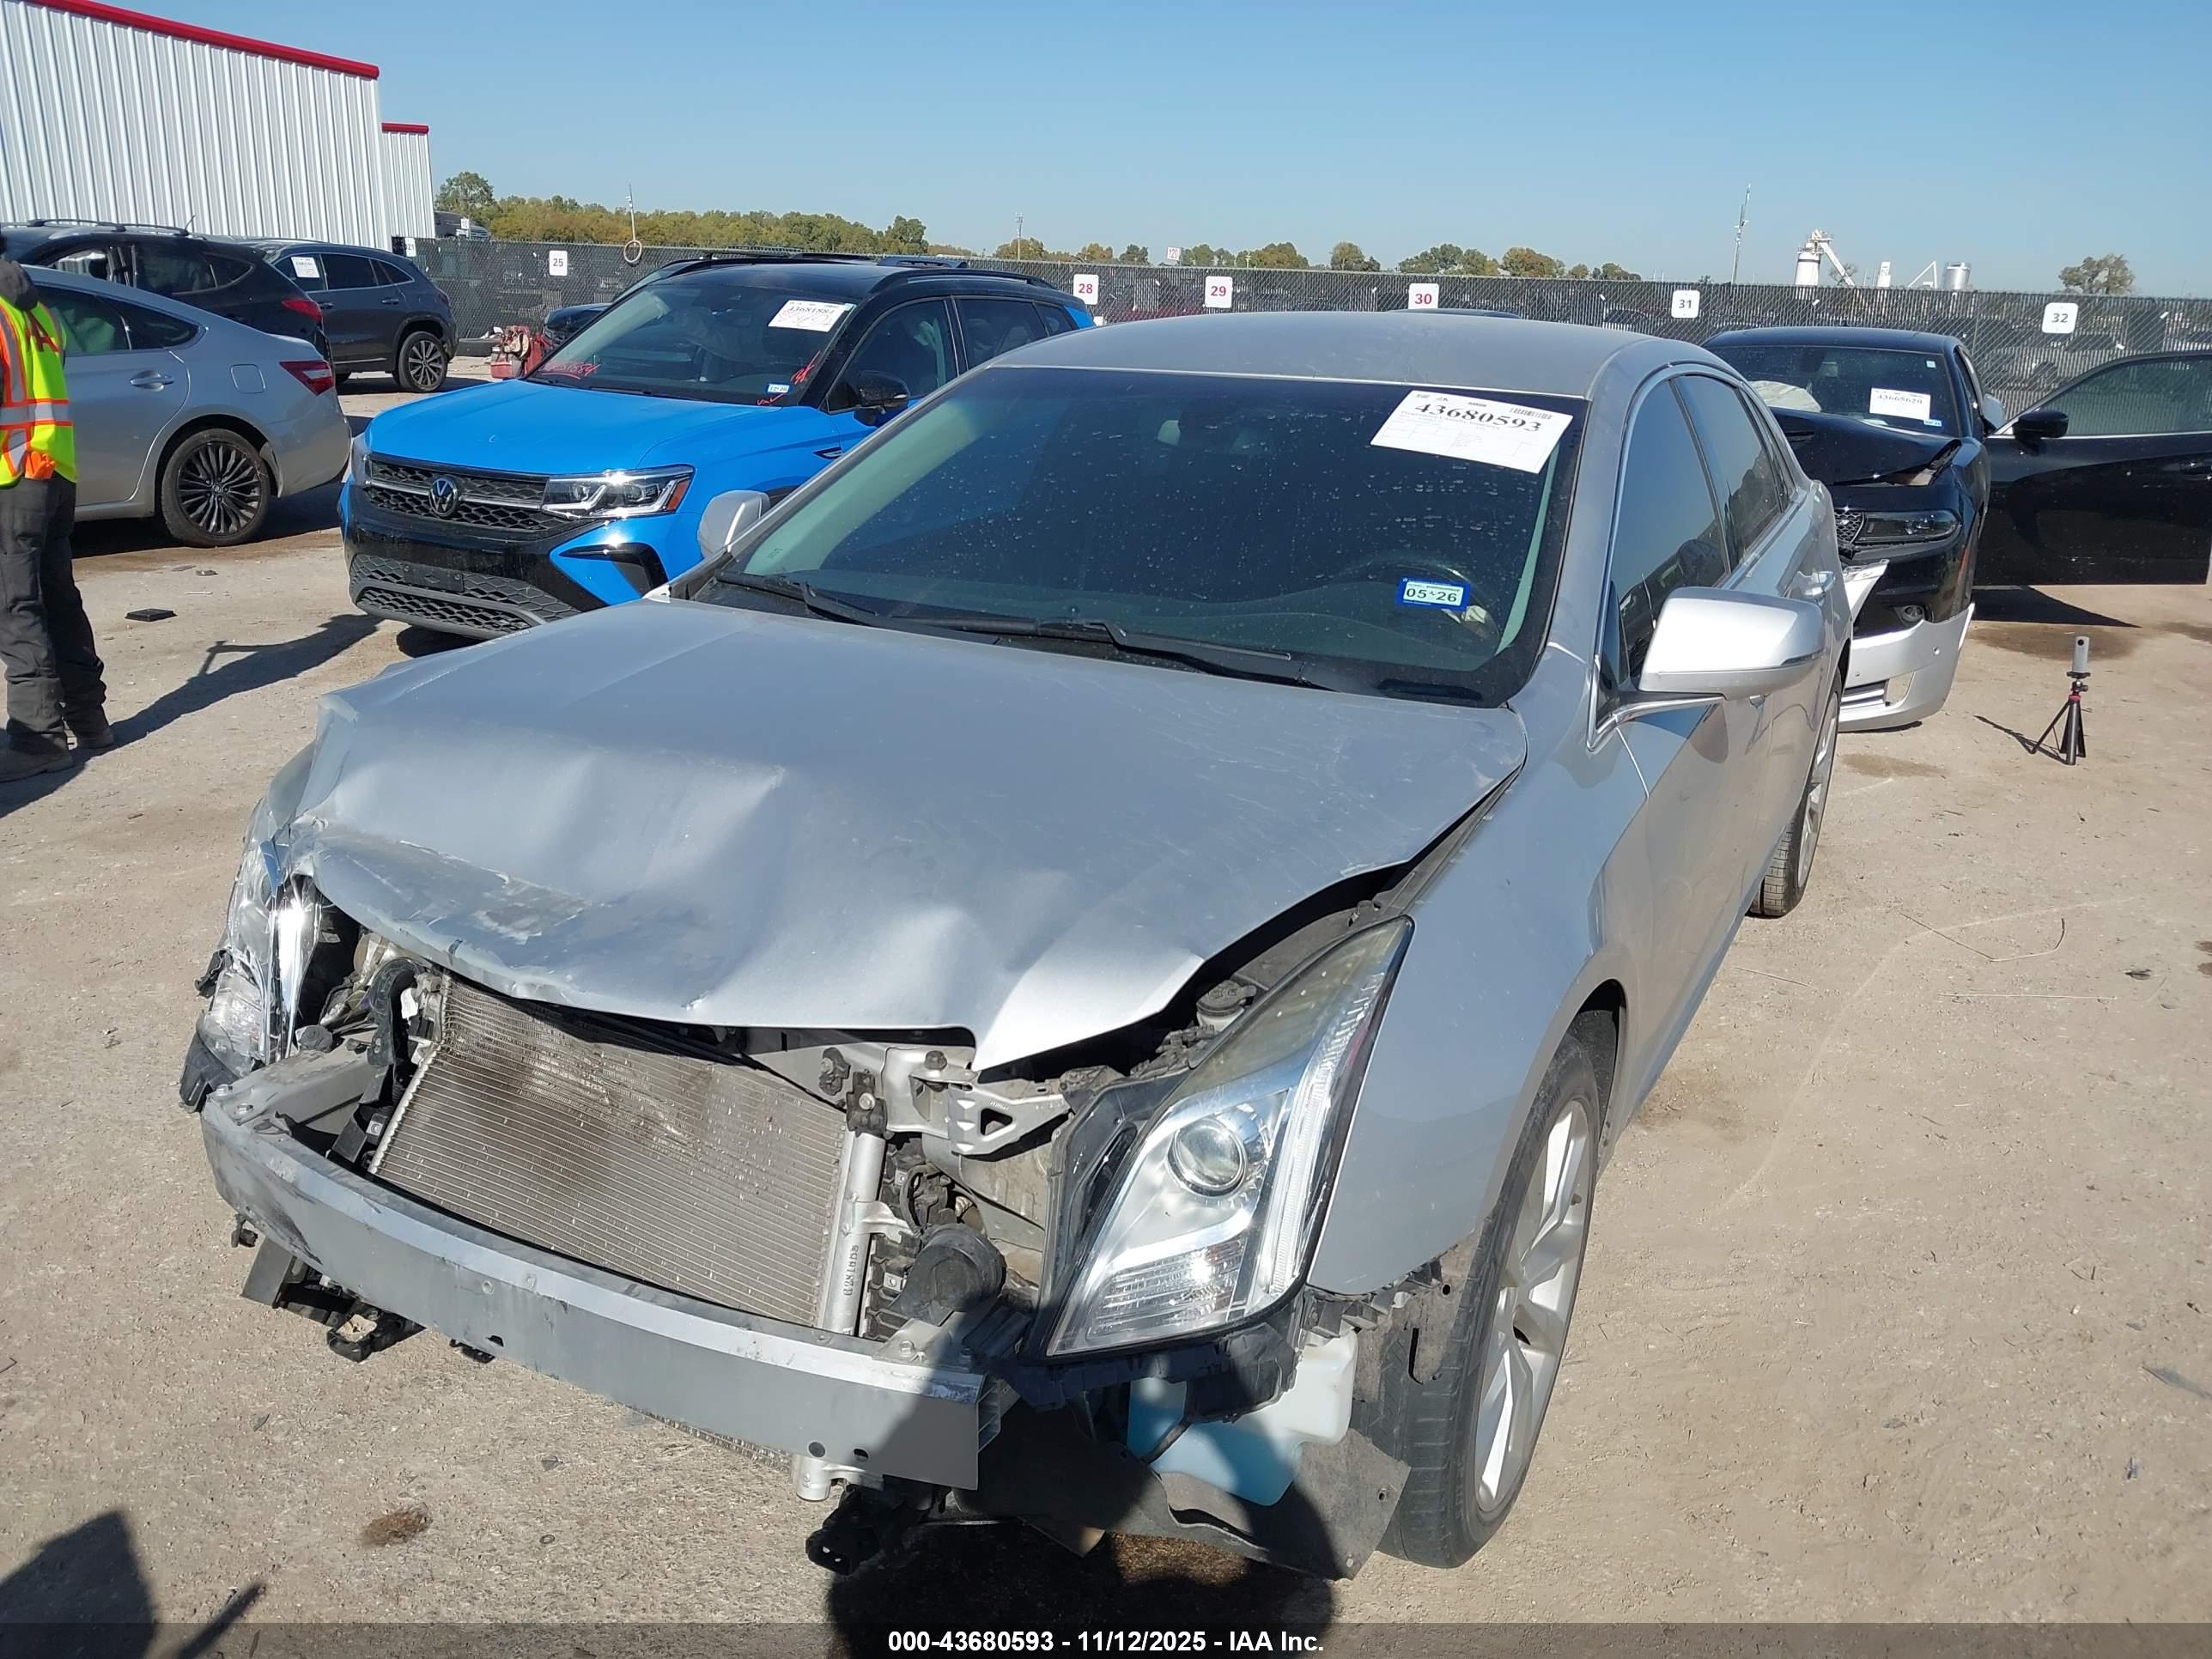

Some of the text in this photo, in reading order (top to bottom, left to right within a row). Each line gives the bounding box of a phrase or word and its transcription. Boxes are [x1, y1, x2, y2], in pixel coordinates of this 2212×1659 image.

[552, 258, 564, 268] 25
[1078, 283, 1093, 295] 28
[1210, 285, 1227, 297] 29
[1414, 293, 1433, 306] 30
[1678, 299, 1693, 310] 31
[2051, 313, 2069, 324] 32
[1414, 403, 1543, 432] 43680593
